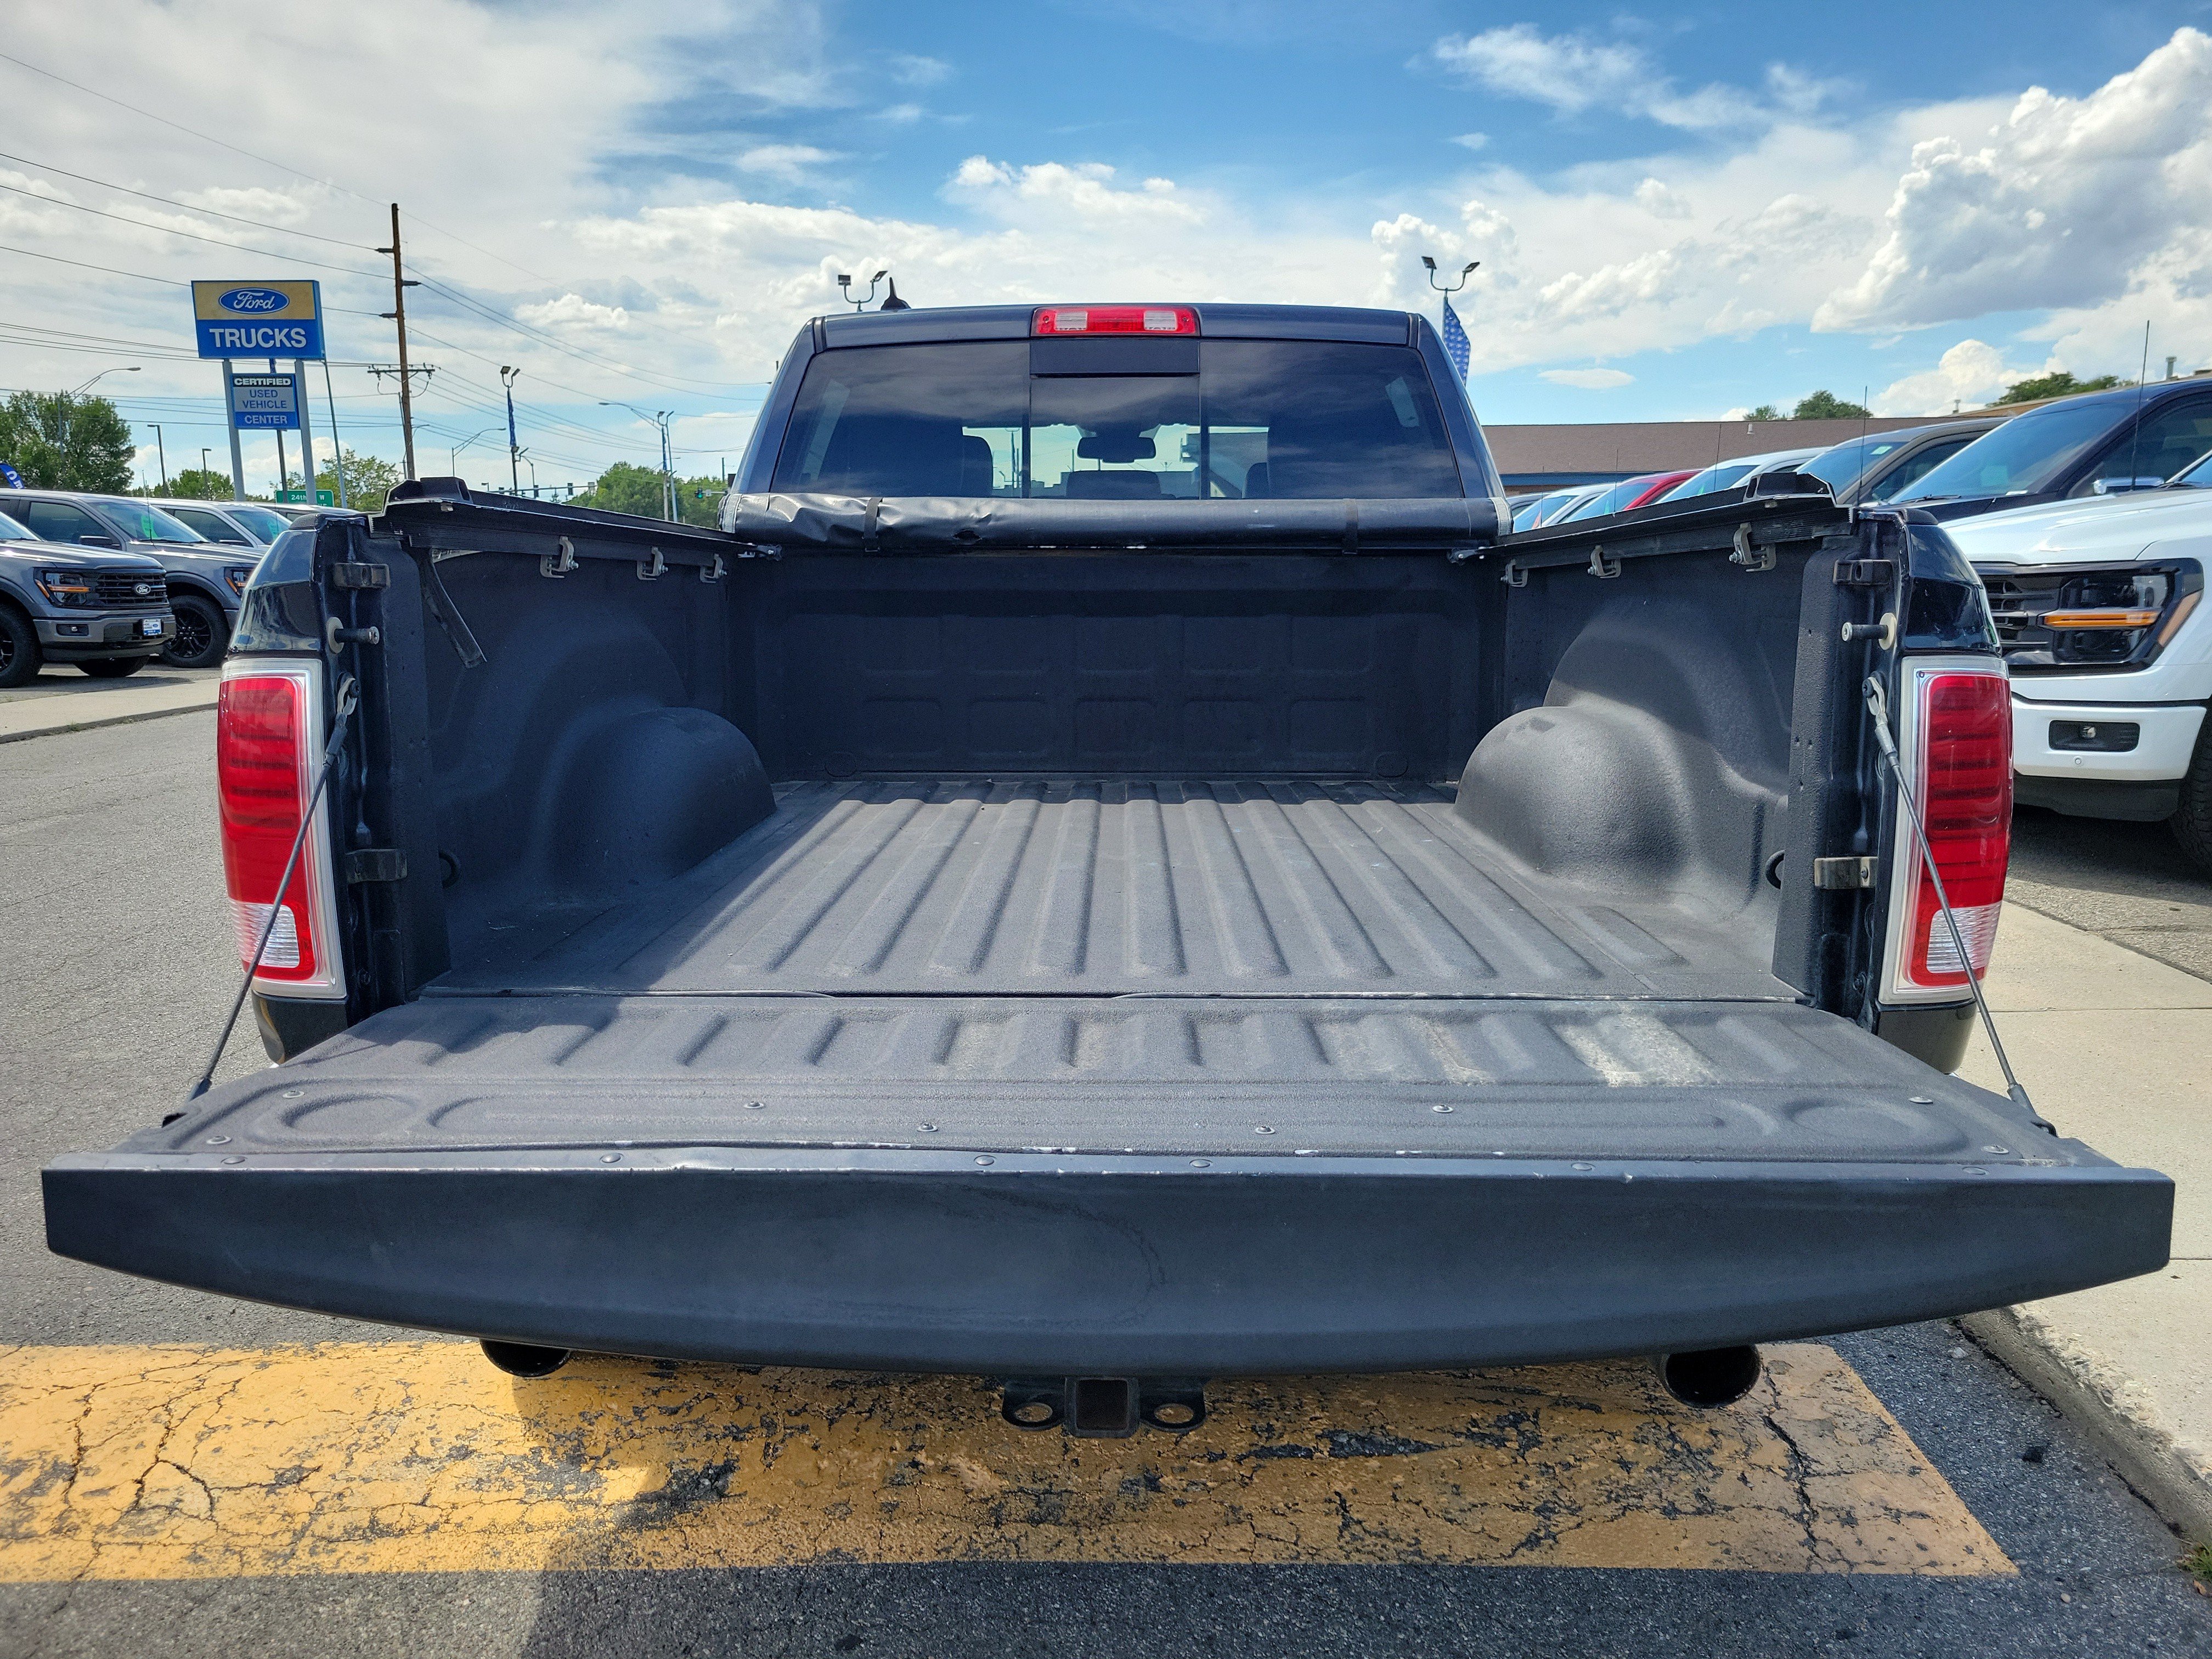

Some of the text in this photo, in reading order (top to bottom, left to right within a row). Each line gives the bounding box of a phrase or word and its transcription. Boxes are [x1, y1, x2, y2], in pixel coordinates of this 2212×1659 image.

[233, 291, 275, 309] Ford
[209, 328, 307, 348] TRUCKS
[234, 377, 292, 386] CERTIFIED
[249, 389, 279, 398] USED
[242, 399, 287, 409] VEHICLE
[244, 415, 288, 425] CENTER
